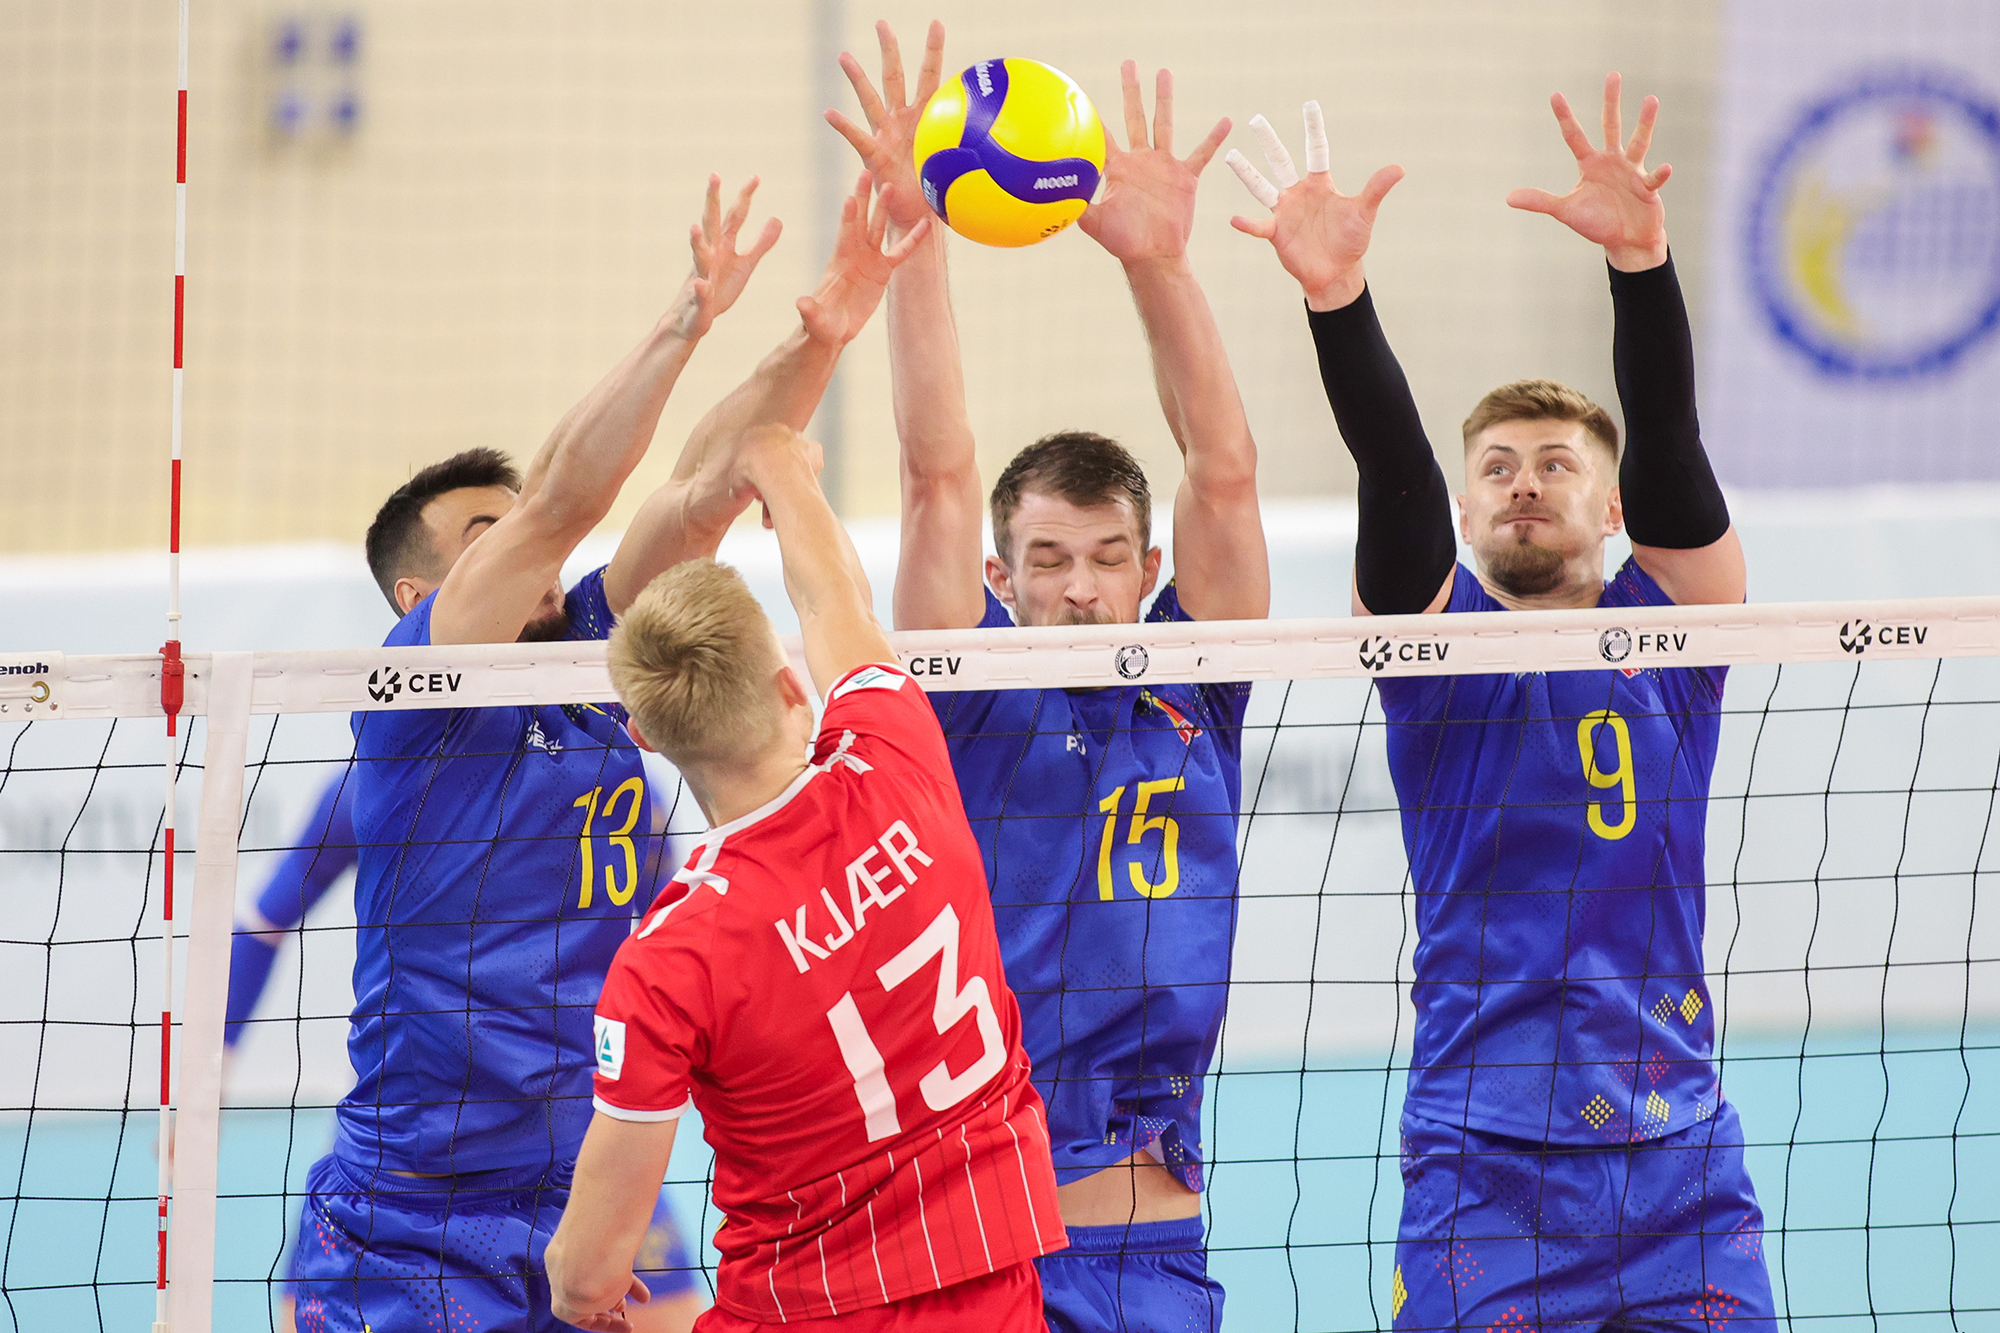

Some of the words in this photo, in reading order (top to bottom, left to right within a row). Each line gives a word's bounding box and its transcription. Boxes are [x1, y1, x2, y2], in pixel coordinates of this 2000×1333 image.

[909, 657, 962, 676] CEV
[1398, 643, 1449, 662] CEV
[1639, 633, 1688, 653] FRV
[1879, 627, 1928, 645] CEV
[407, 672, 463, 693] CEV
[1577, 709, 1637, 840] 9
[573, 776, 645, 909] 13
[1097, 776, 1186, 901] 15
[775, 819, 934, 974] KJÆR
[827, 903, 1007, 1143] 13
